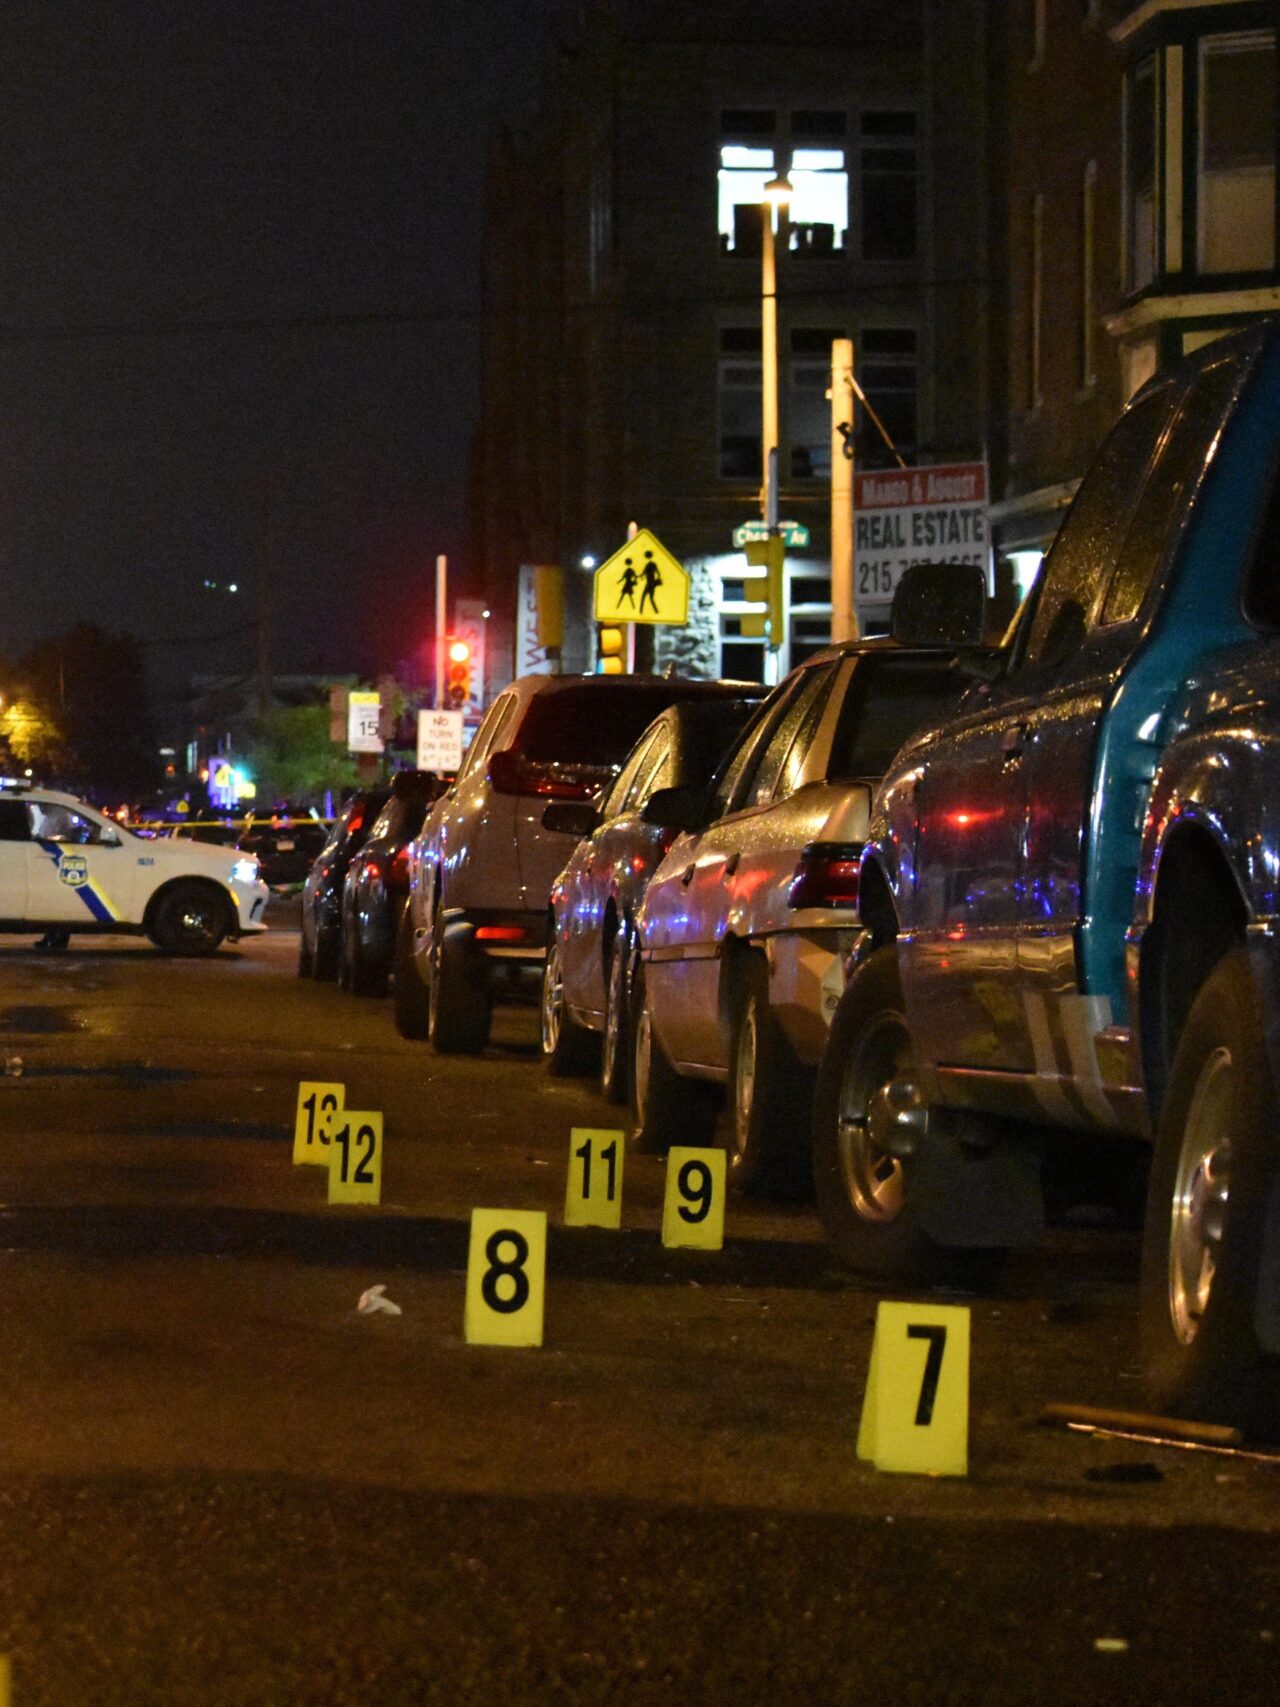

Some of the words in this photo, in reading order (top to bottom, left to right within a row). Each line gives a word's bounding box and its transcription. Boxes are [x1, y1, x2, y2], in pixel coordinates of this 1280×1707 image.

[790, 530, 807, 545] Av
[857, 515, 906, 549] REAL
[912, 509, 982, 546] ESTATE
[359, 721, 379, 737] 15
[429, 729, 453, 738] TURN
[432, 715, 449, 727] NO
[422, 741, 435, 751] ON
[439, 741, 458, 751] RED
[303, 1093, 337, 1145] 13
[335, 1123, 375, 1184] 12
[576, 1139, 617, 1201] 11
[677, 1160, 713, 1224] 9
[482, 1229, 529, 1314] 8
[907, 1324, 947, 1426] 7
